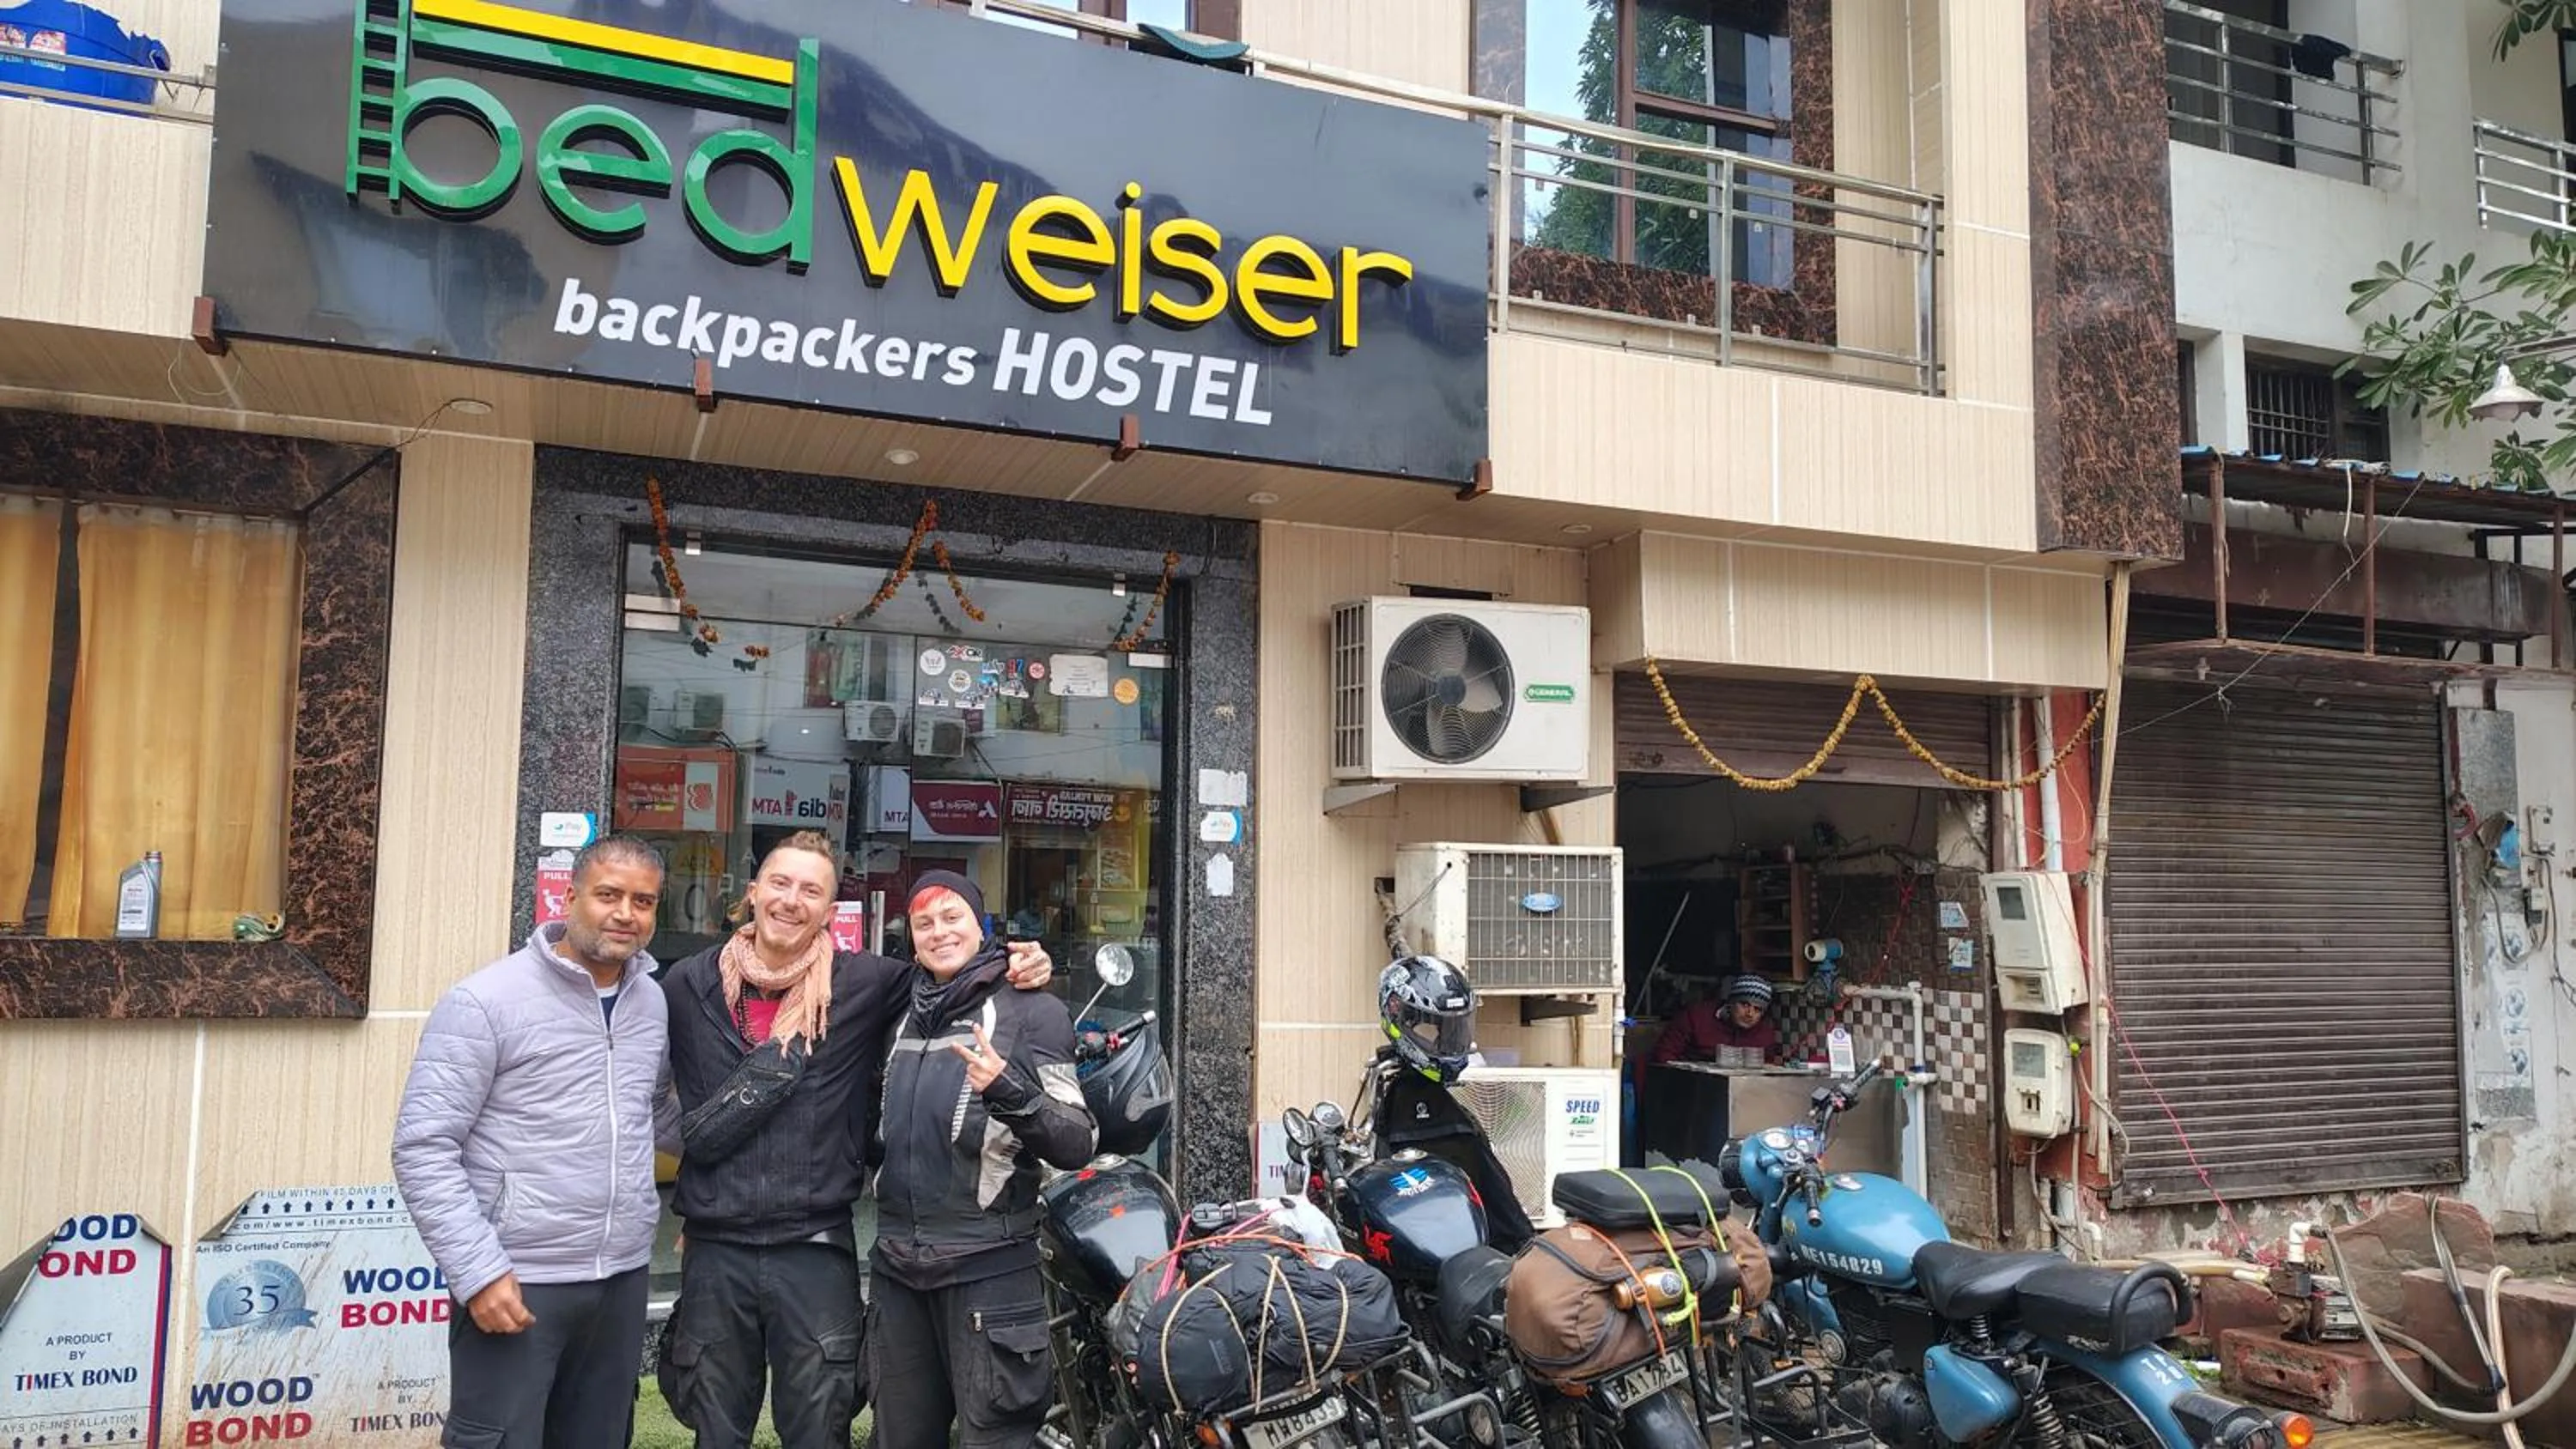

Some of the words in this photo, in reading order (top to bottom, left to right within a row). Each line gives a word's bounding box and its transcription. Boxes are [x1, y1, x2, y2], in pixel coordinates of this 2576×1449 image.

[554, 278, 977, 386] backpackers
[993, 327, 1272, 426] HOSTEL
[1566, 1100, 1600, 1113] SPEED
[289, 1188, 329, 1197] WITHIN
[349, 1186, 377, 1196] DAYS
[54, 1214, 137, 1241] OOD
[212, 1244, 233, 1252] ISO
[234, 1242, 279, 1252] Certified
[282, 1240, 331, 1250] Company
[38, 1249, 137, 1277] OND
[234, 1285, 281, 1316] 35
[46, 1337, 54, 1346] A
[57, 1332, 112, 1345] PRODUCT
[69, 1350, 87, 1361] BY
[15, 1372, 74, 1391] TIMEX
[82, 1367, 137, 1386] BOND
[388, 1378, 436, 1389] PRODUCT
[191, 1376, 313, 1411] WOOD
[0, 1423, 25, 1434] AYS
[185, 1412, 312, 1446] BOND
[350, 1415, 403, 1433] TIMEX
[410, 1412, 447, 1429] BON
